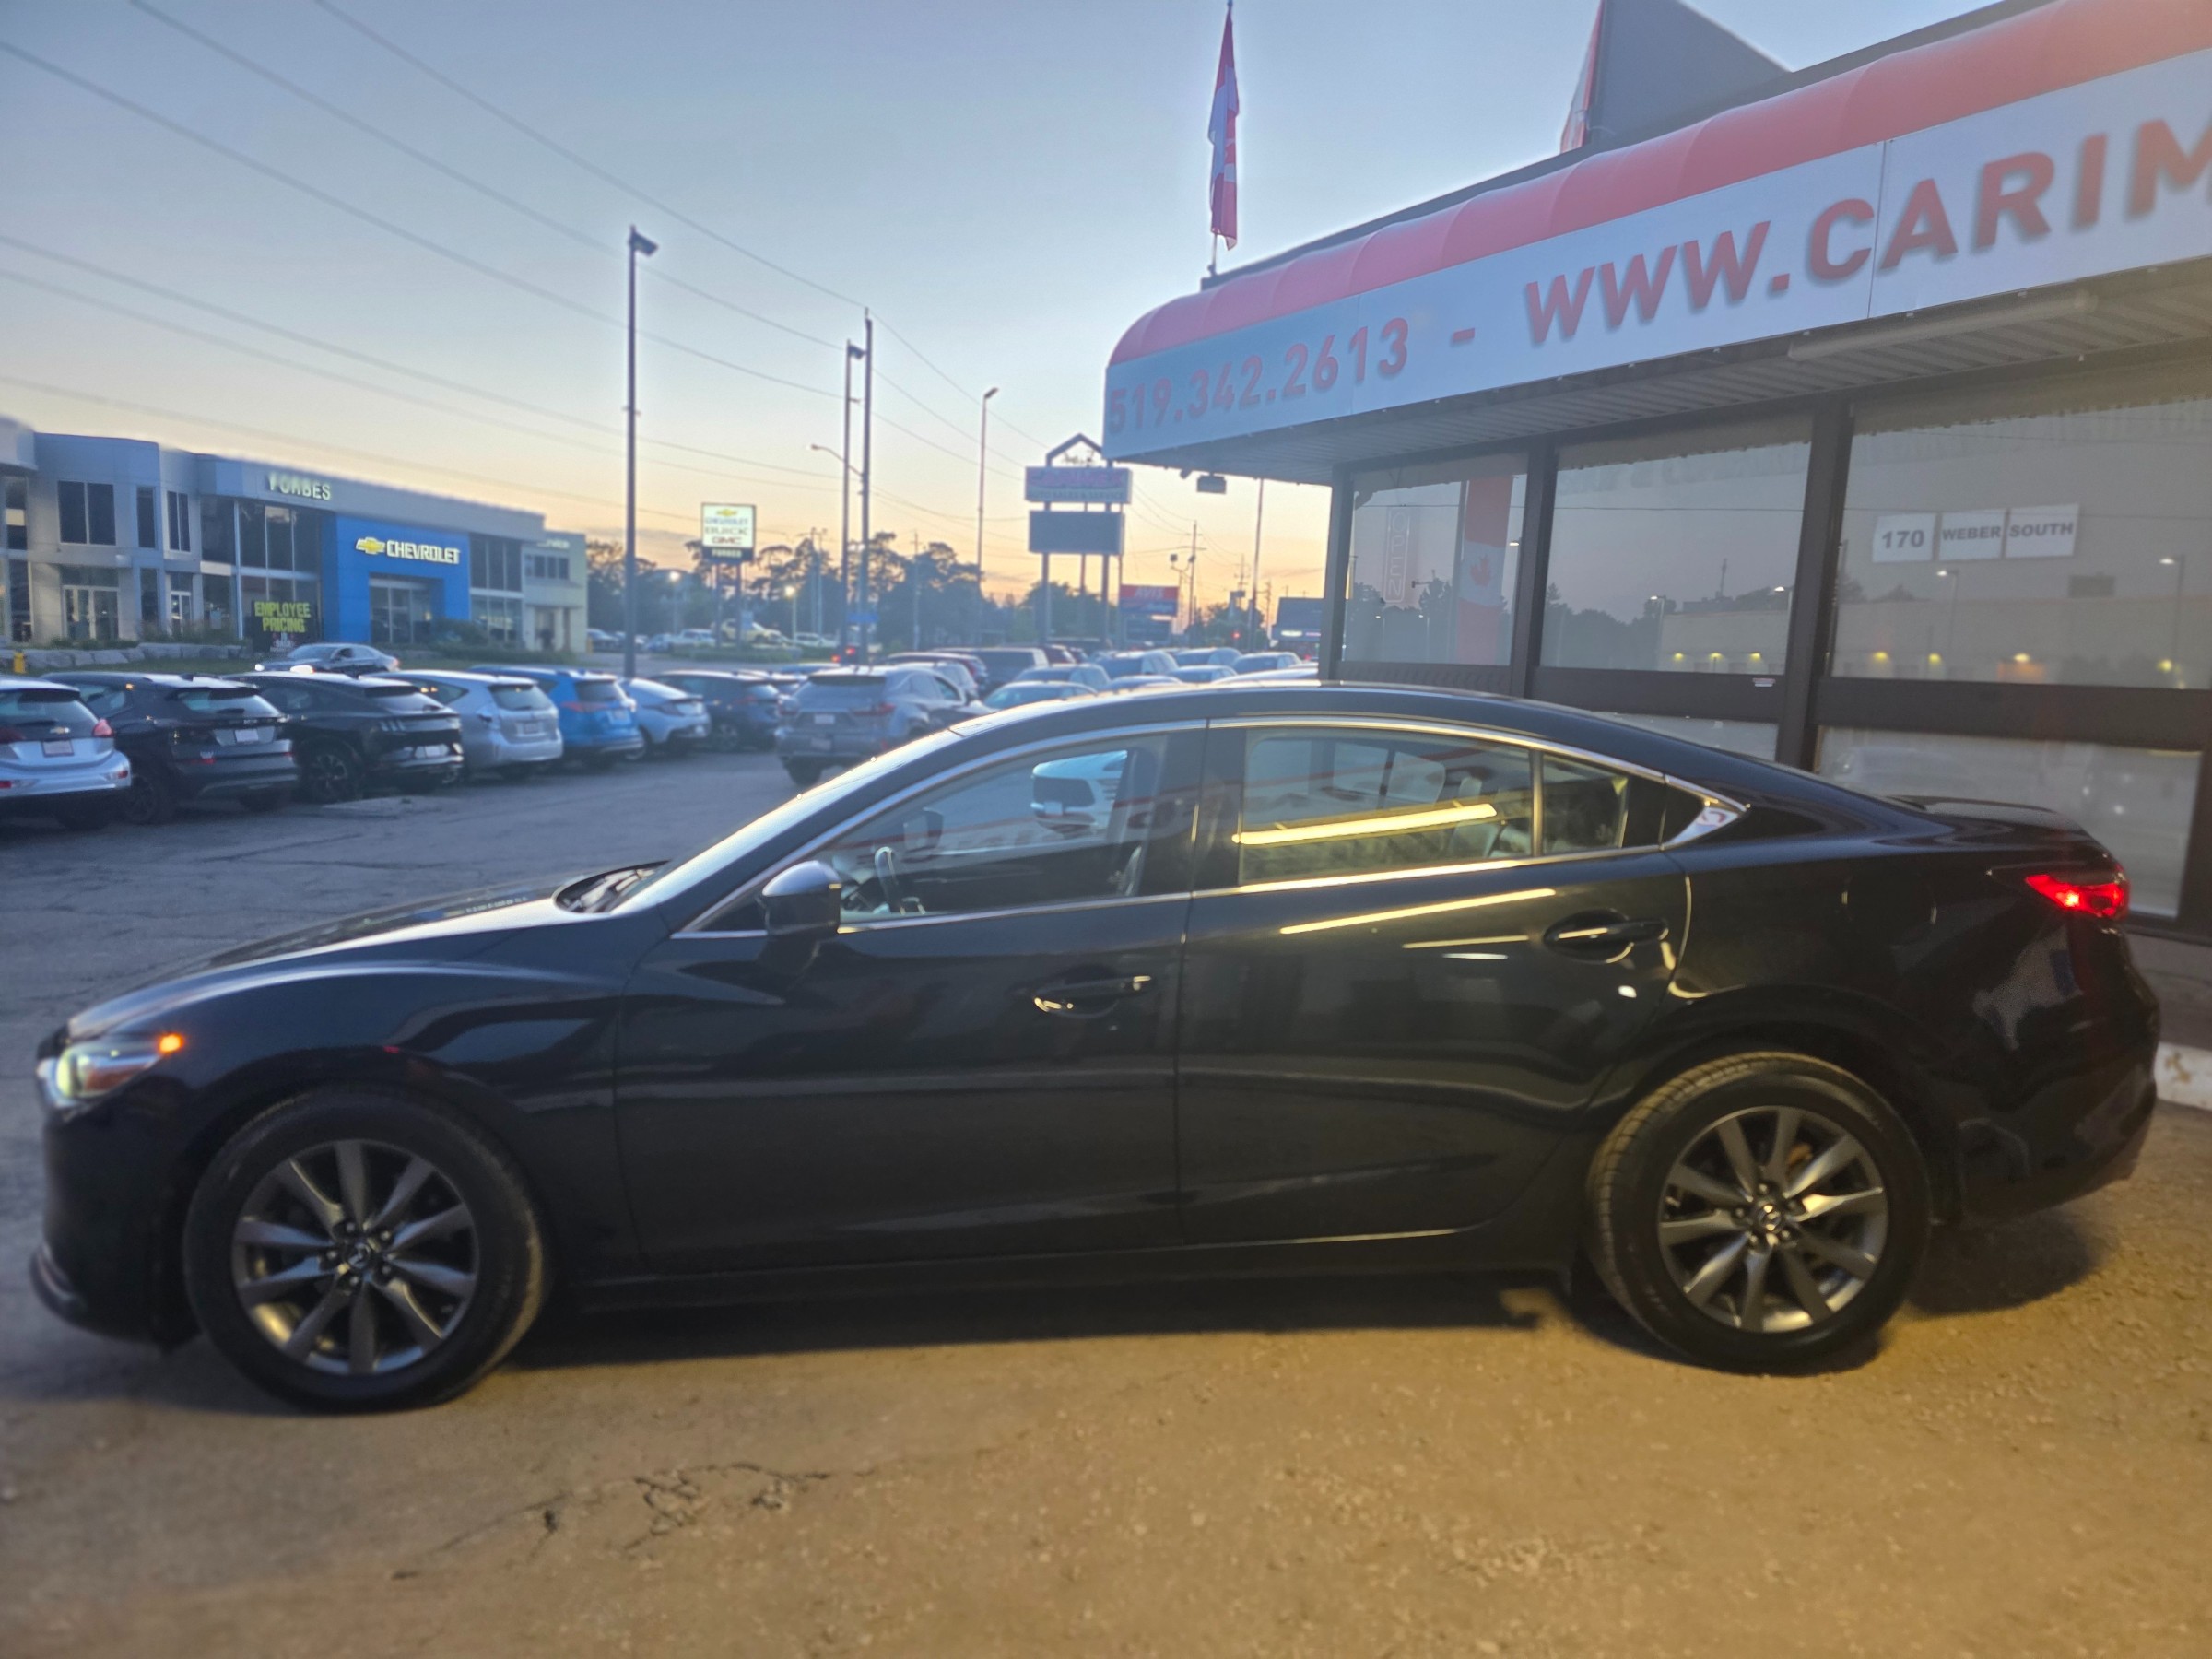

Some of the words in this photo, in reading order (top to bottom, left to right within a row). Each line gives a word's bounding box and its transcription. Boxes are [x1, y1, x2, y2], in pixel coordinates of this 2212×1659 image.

[1109, 317, 1408, 433] 519.342.2613
[1881, 529, 1925, 549] 170
[1942, 525, 2002, 541] WEBER
[2008, 522, 2074, 538] SOUTH
[386, 539, 461, 564] CHEVROLET
[1388, 512, 1406, 596] OPEN
[254, 601, 312, 618] EMPLOYEE
[262, 617, 306, 634] PRICING
